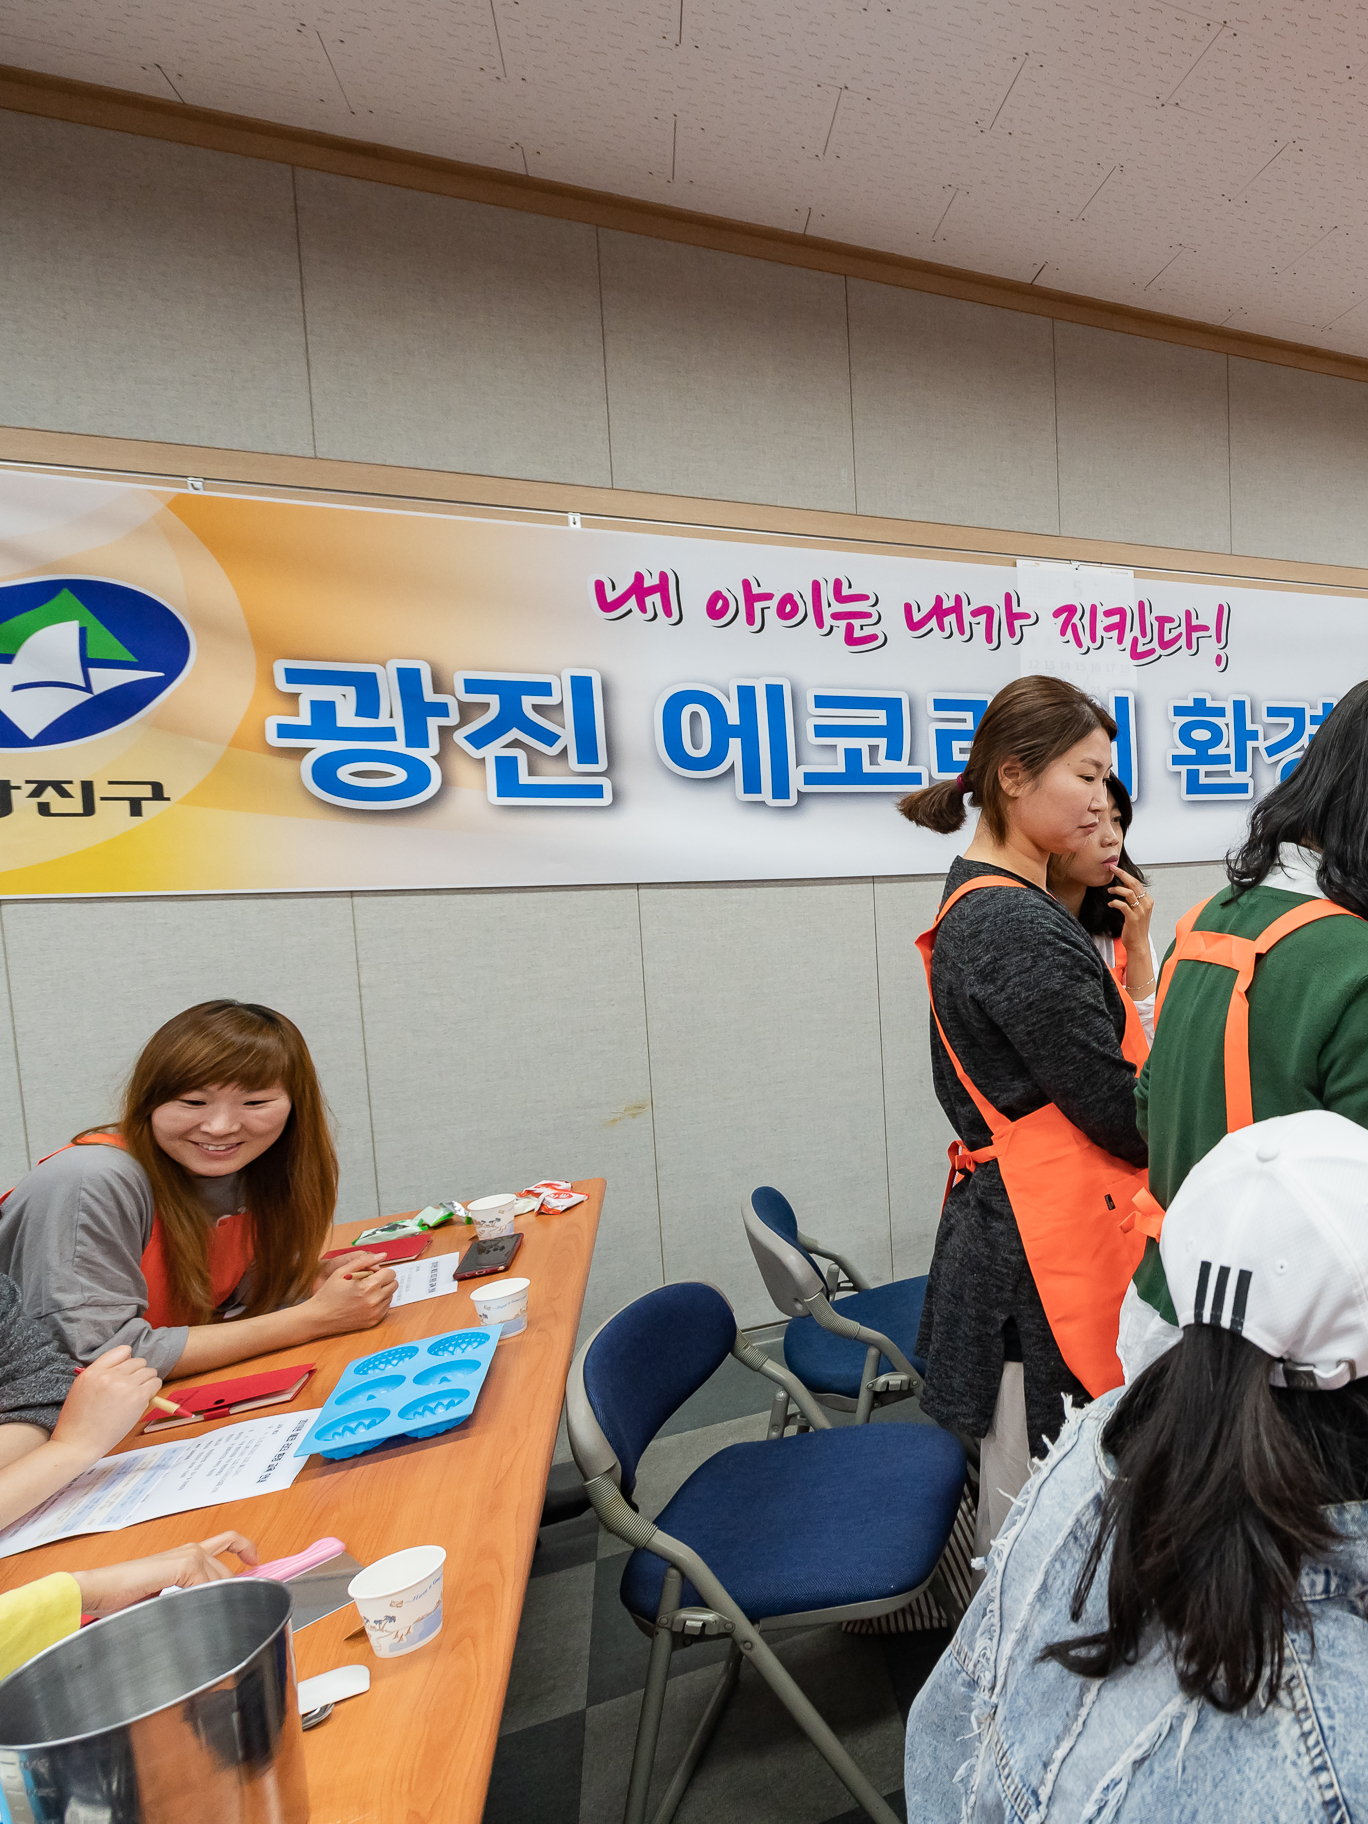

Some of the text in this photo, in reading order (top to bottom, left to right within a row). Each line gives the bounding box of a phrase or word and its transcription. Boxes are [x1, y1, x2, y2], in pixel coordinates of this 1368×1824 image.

[592, 569, 1228, 670] 내 아이는 내가 지킨다!
[271, 664, 608, 805] 광진
[659, 681, 1136, 803] 에코
